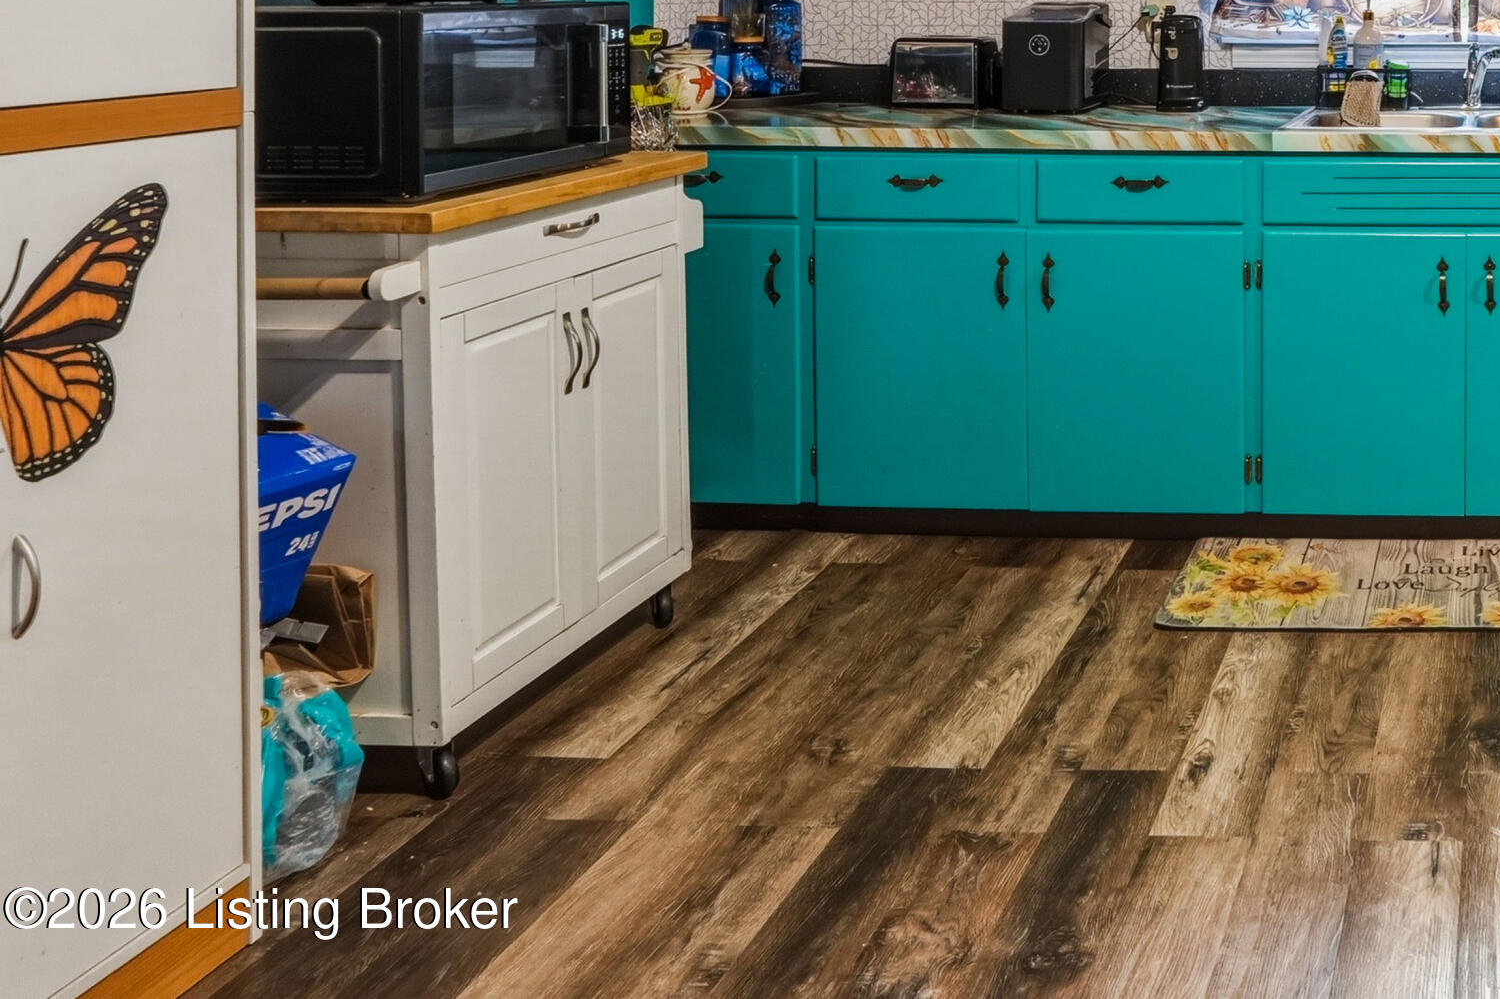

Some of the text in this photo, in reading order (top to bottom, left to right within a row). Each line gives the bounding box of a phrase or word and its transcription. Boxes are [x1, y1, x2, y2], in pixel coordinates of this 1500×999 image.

[258, 483, 342, 533] EPSI
[284, 533, 310, 557] 24
[1403, 562, 1489, 578] Laugh
[1356, 578, 1426, 591] Love
